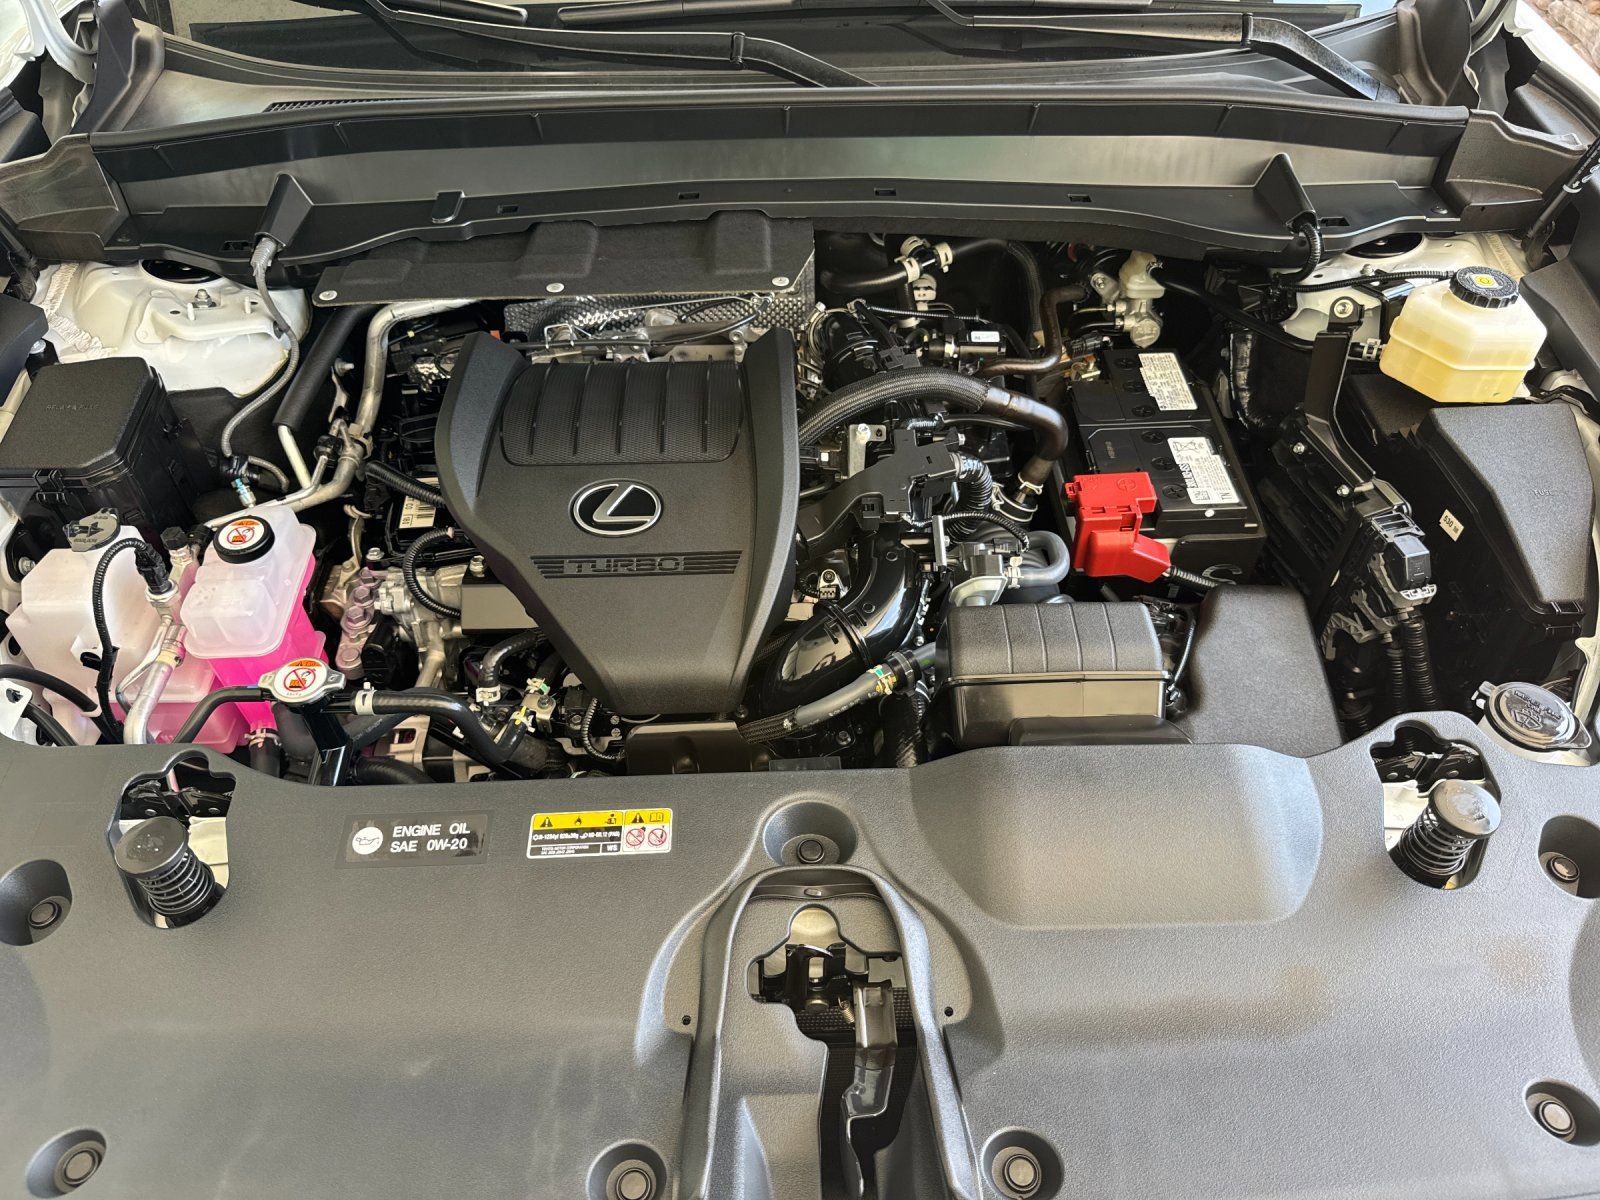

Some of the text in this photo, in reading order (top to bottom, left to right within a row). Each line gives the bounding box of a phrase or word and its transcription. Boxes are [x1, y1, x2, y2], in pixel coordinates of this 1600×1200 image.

[567, 557, 681, 574] TURBO
[392, 822, 471, 838] ENGINE OIL
[389, 838, 468, 853] SAE 0W-20
